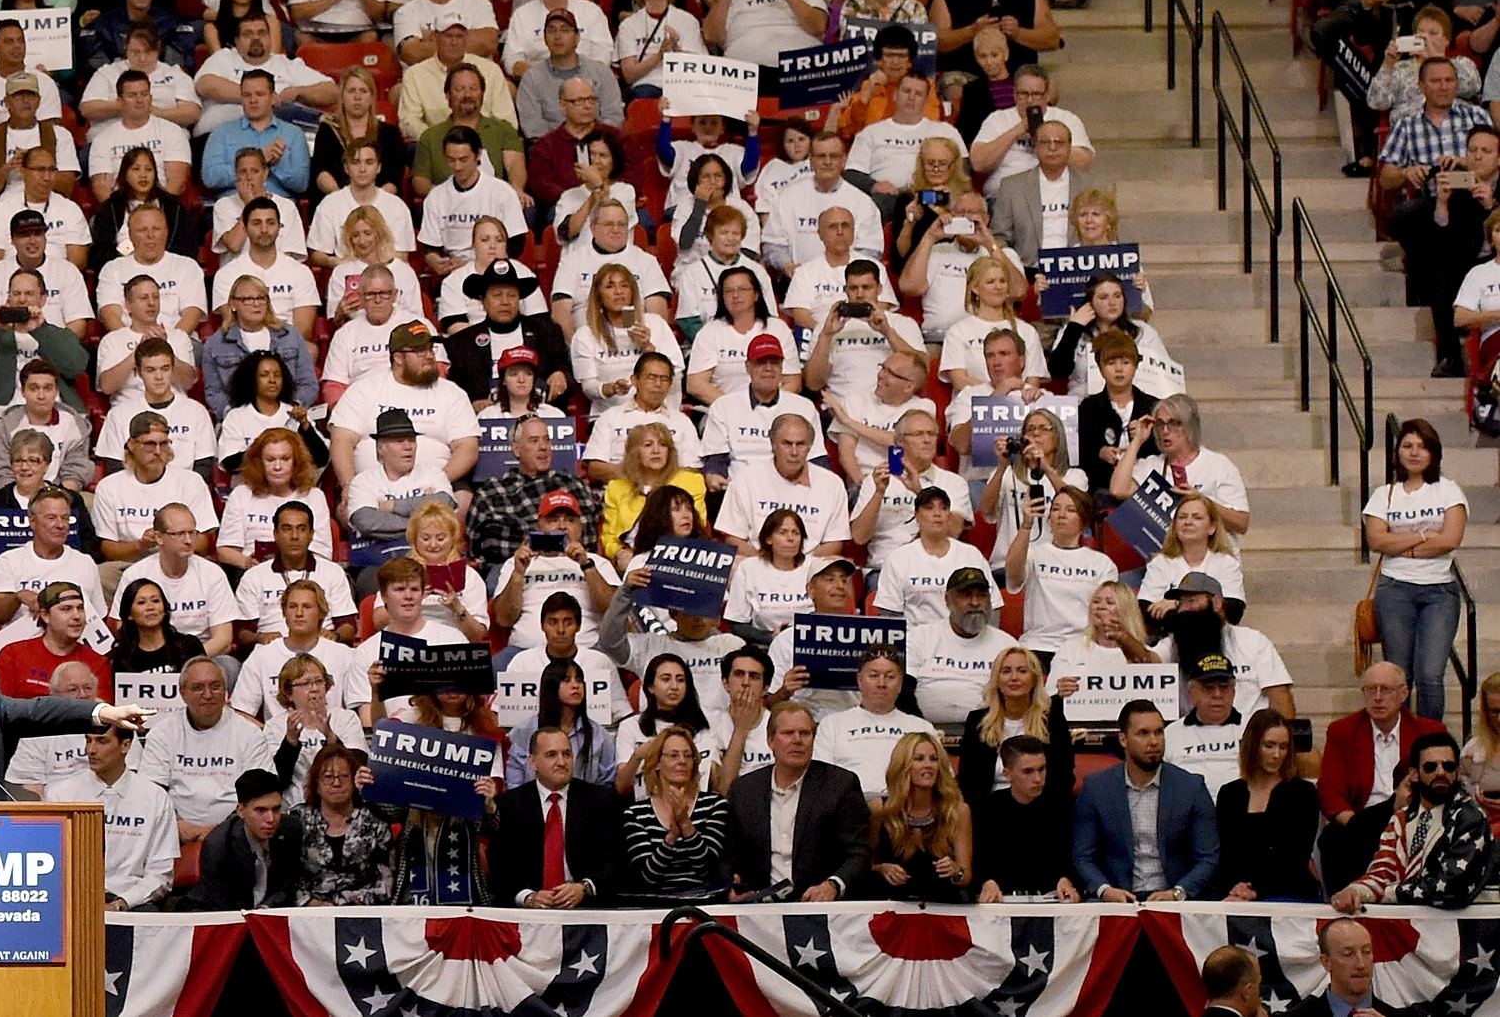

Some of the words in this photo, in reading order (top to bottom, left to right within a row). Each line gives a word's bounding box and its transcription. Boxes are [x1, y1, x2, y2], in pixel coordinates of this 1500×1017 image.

[845, 23, 937, 45] TRP
[780, 45, 867, 73] TRUMP
[665, 61, 756, 80] TRUMP
[1040, 252, 1138, 273] TRUMP
[836, 337, 887, 346] TRUM
[973, 405, 1076, 421] TRUP
[758, 500, 820, 515] TRUMP
[652, 544, 733, 570] TRUMP
[657, 565, 684, 577] AMERICA
[685, 569, 704, 580] GREAT
[758, 592, 810, 602] TRUM
[795, 624, 905, 645] TRUMP
[381, 641, 489, 664] TRUMP
[795, 647, 815, 656] MAKE
[816, 648, 850, 657] AMERICA
[118, 684, 177, 698] TRU
[500, 681, 608, 697] TRP
[375, 729, 493, 767] TRUMP
[1184, 741, 1235, 754] TRUM
[176, 755, 234, 767] TRUMP
[371, 752, 393, 765] MAKE
[395, 759, 431, 772] AMERICA
[432, 766, 458, 777] GREAT
[2, 890, 48, 903] 88022
[12, 951, 49, 960] AGAIN!
